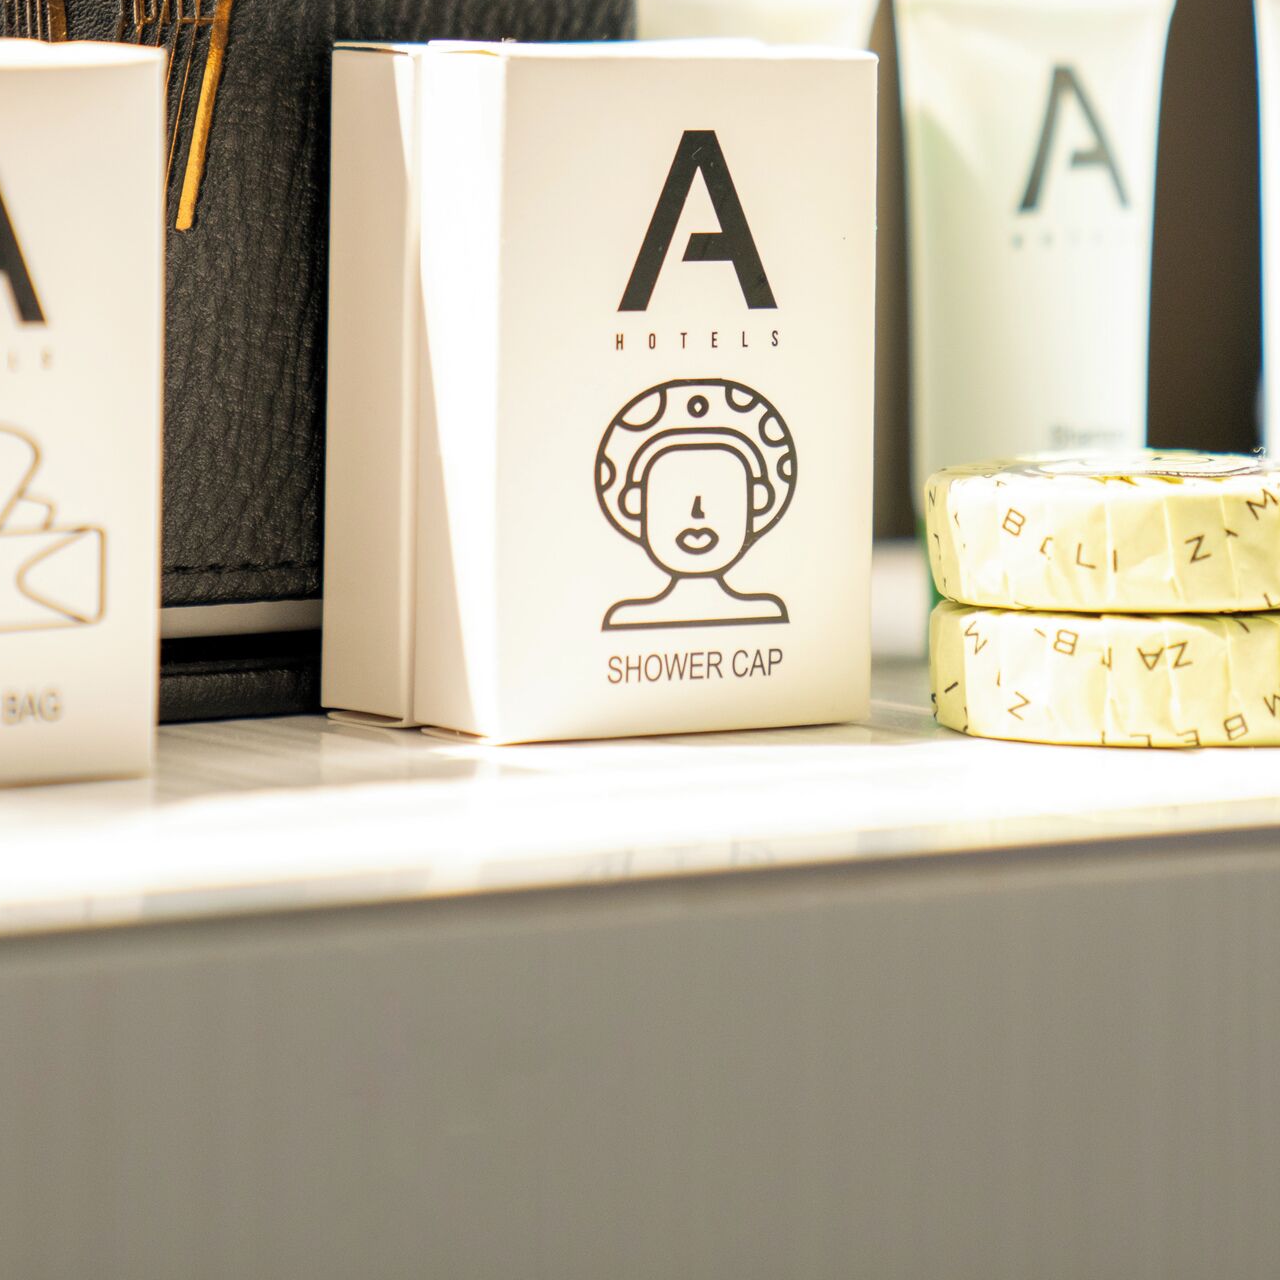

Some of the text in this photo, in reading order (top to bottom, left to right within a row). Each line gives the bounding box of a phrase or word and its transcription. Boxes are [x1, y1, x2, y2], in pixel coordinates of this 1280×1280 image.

[1017, 61, 1130, 214] A
[617, 129, 778, 312] A
[616, 329, 779, 351] HOTELS
[607, 648, 784, 684] SHOWER CAP
[1, 686, 63, 725] BAG
